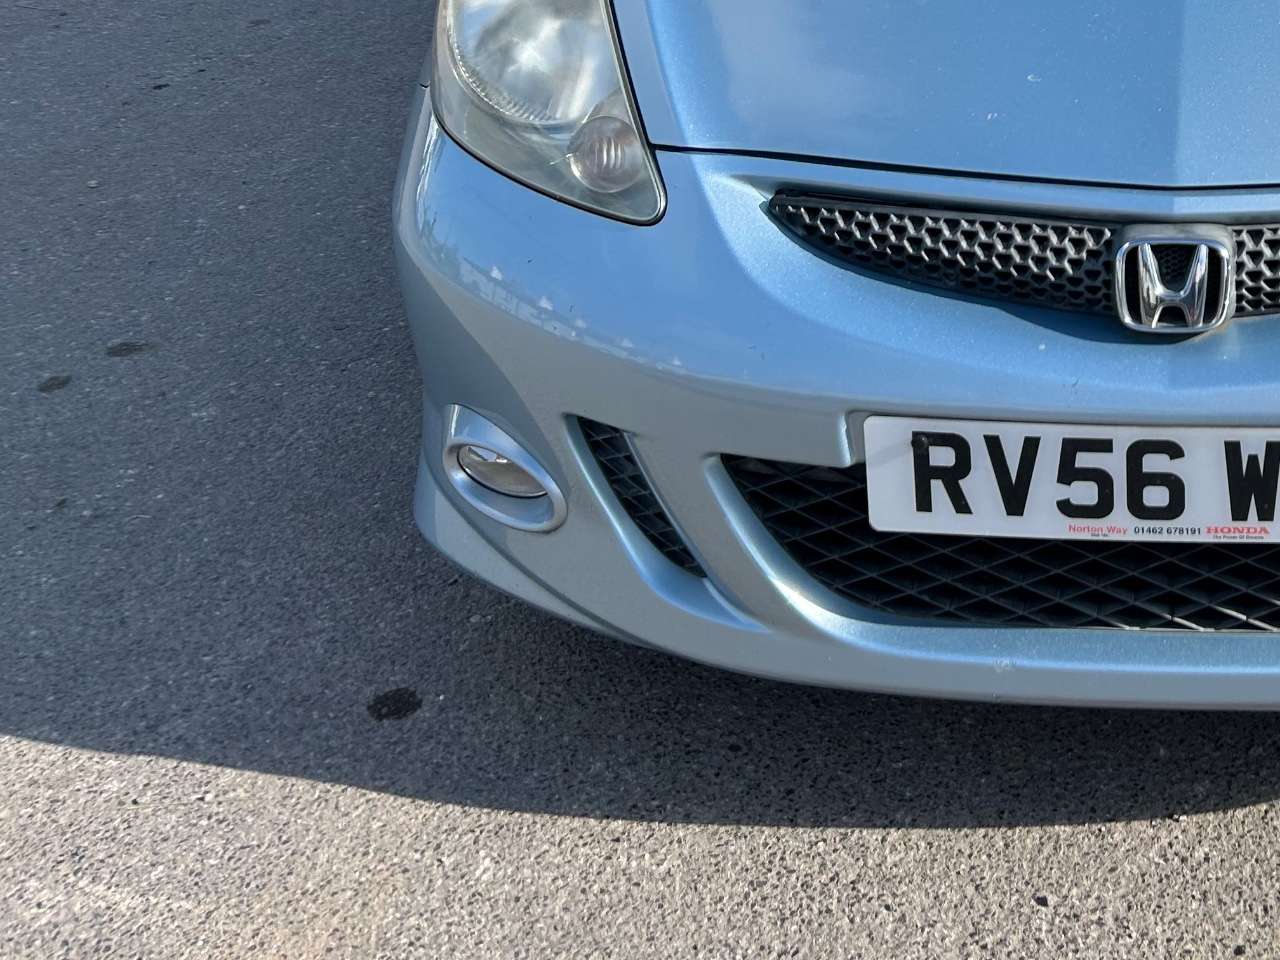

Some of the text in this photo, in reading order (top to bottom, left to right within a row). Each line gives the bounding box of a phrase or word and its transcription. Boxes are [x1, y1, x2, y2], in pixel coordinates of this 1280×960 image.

[911, 430, 1186, 521] RV56
[1068, 524, 1105, 534] Norton
[1106, 526, 1128, 536] Way
[1134, 526, 1163, 535] 01462
[1166, 526, 1201, 536] 678191
[1206, 526, 1270, 535] HONDA
